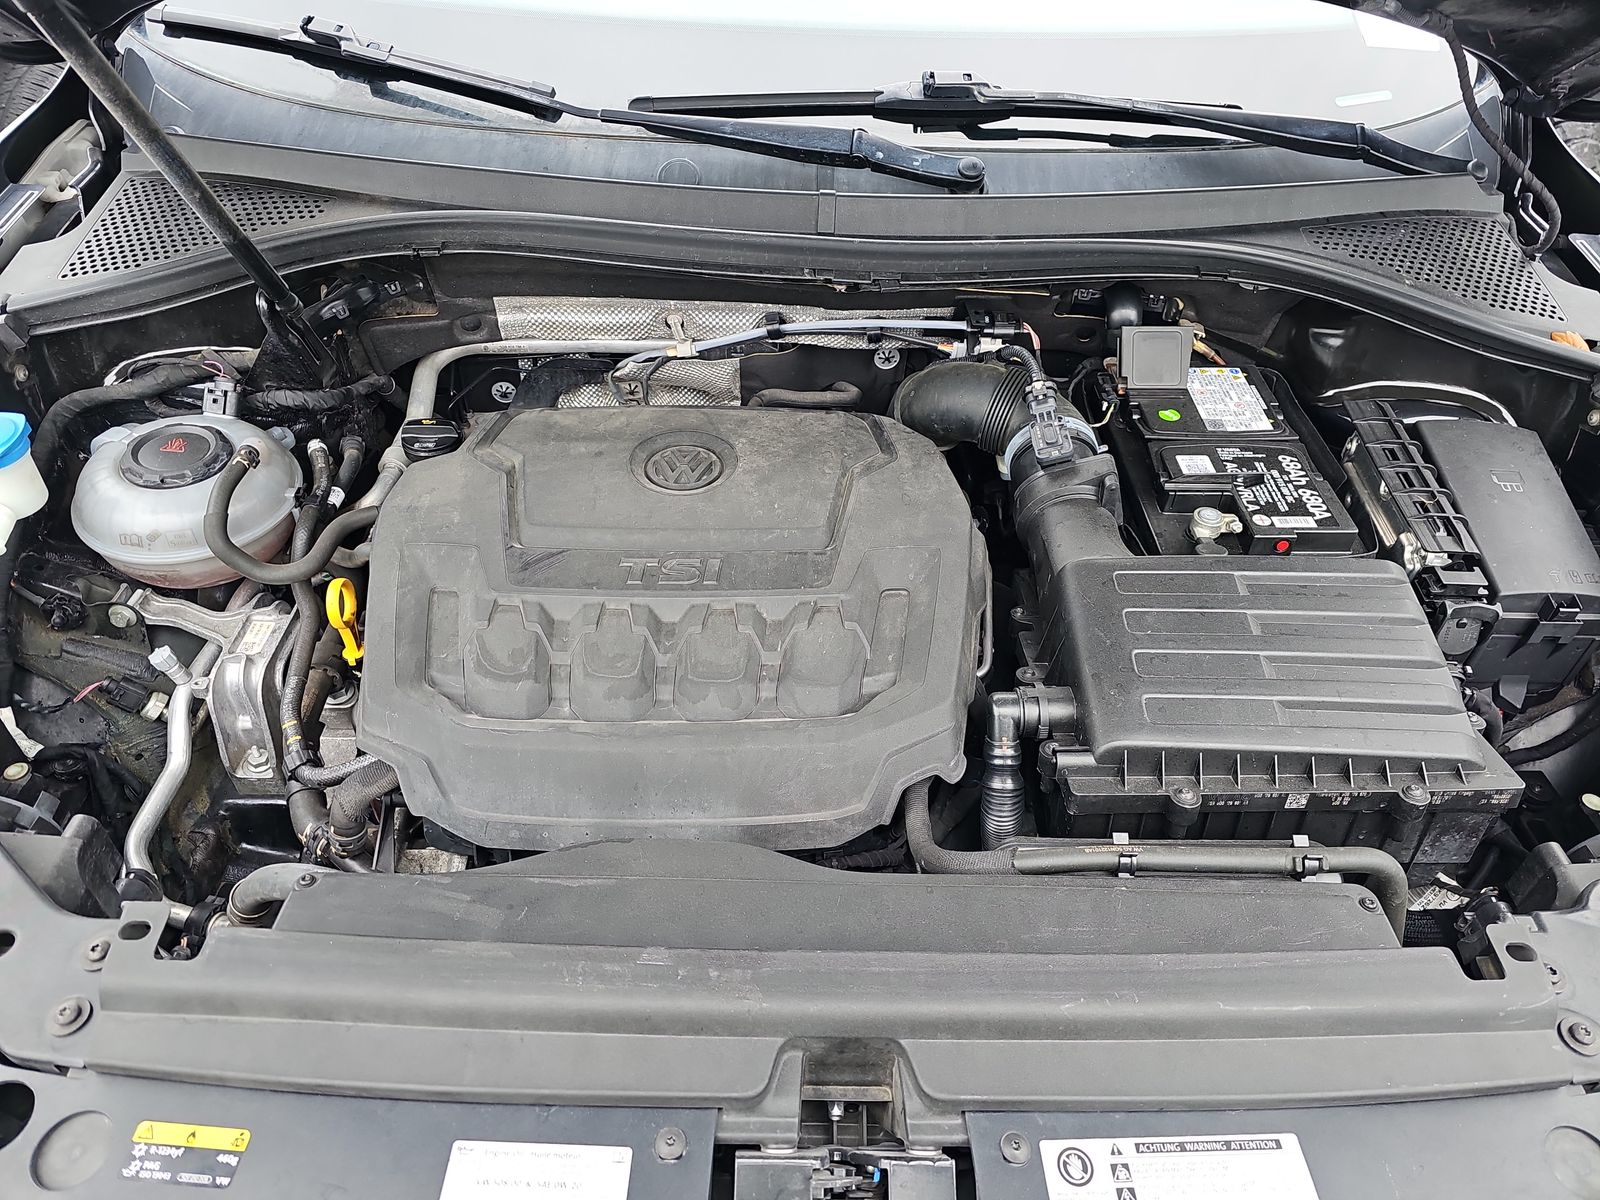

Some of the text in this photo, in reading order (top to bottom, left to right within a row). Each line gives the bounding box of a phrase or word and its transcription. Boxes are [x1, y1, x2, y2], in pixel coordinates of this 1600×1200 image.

[1278, 455, 1310, 485] 68Ah
[1298, 488, 1332, 520] 680A
[619, 557, 723, 585] TSI
[1138, 1140, 1278, 1153] ACHTUNG WARNING ATTENTION
